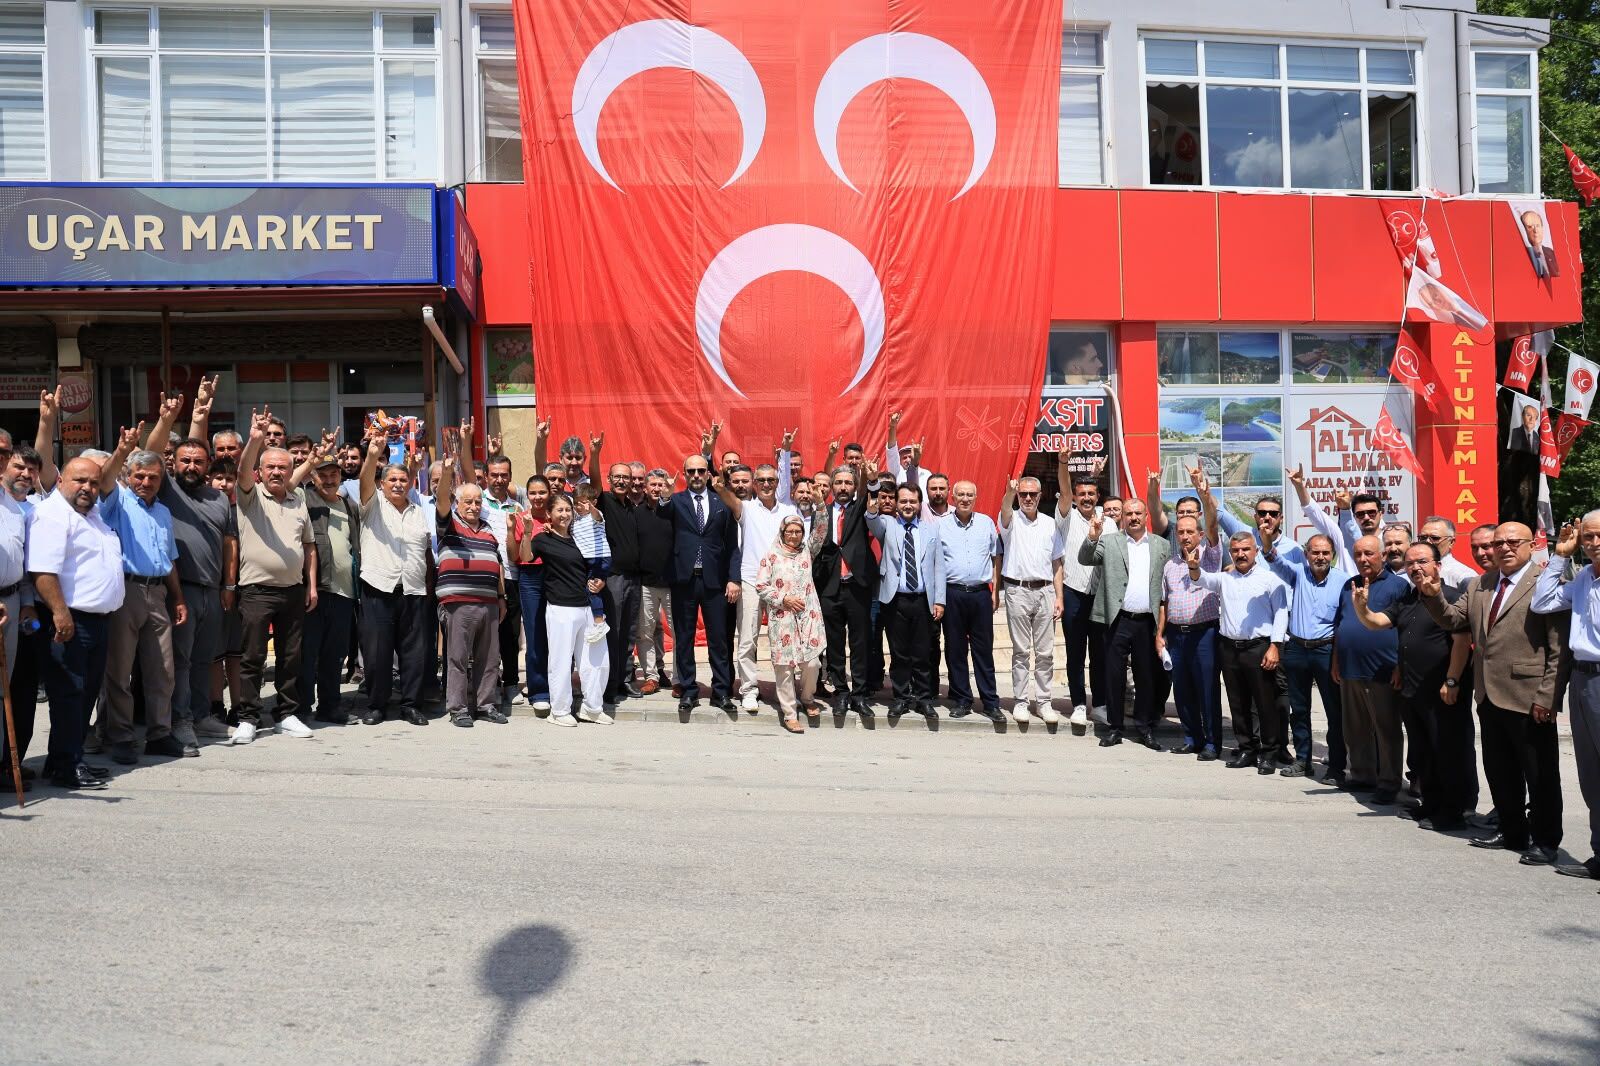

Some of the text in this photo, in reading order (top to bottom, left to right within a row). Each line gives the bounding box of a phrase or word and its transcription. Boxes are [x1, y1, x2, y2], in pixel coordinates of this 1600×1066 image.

[27, 214, 383, 261] UÇAR MARKET
[459, 223, 474, 277] UÇAR
[1452, 332, 1474, 420] ALTUN
[1318, 429, 1402, 452] ALTU
[1302, 477, 1334, 488] ARLA
[1336, 477, 1345, 488] &
[1378, 476, 1387, 487] &
[1388, 475, 1403, 487] EV
[1454, 431, 1478, 524] EMLAK
[1387, 503, 1400, 515] 55
